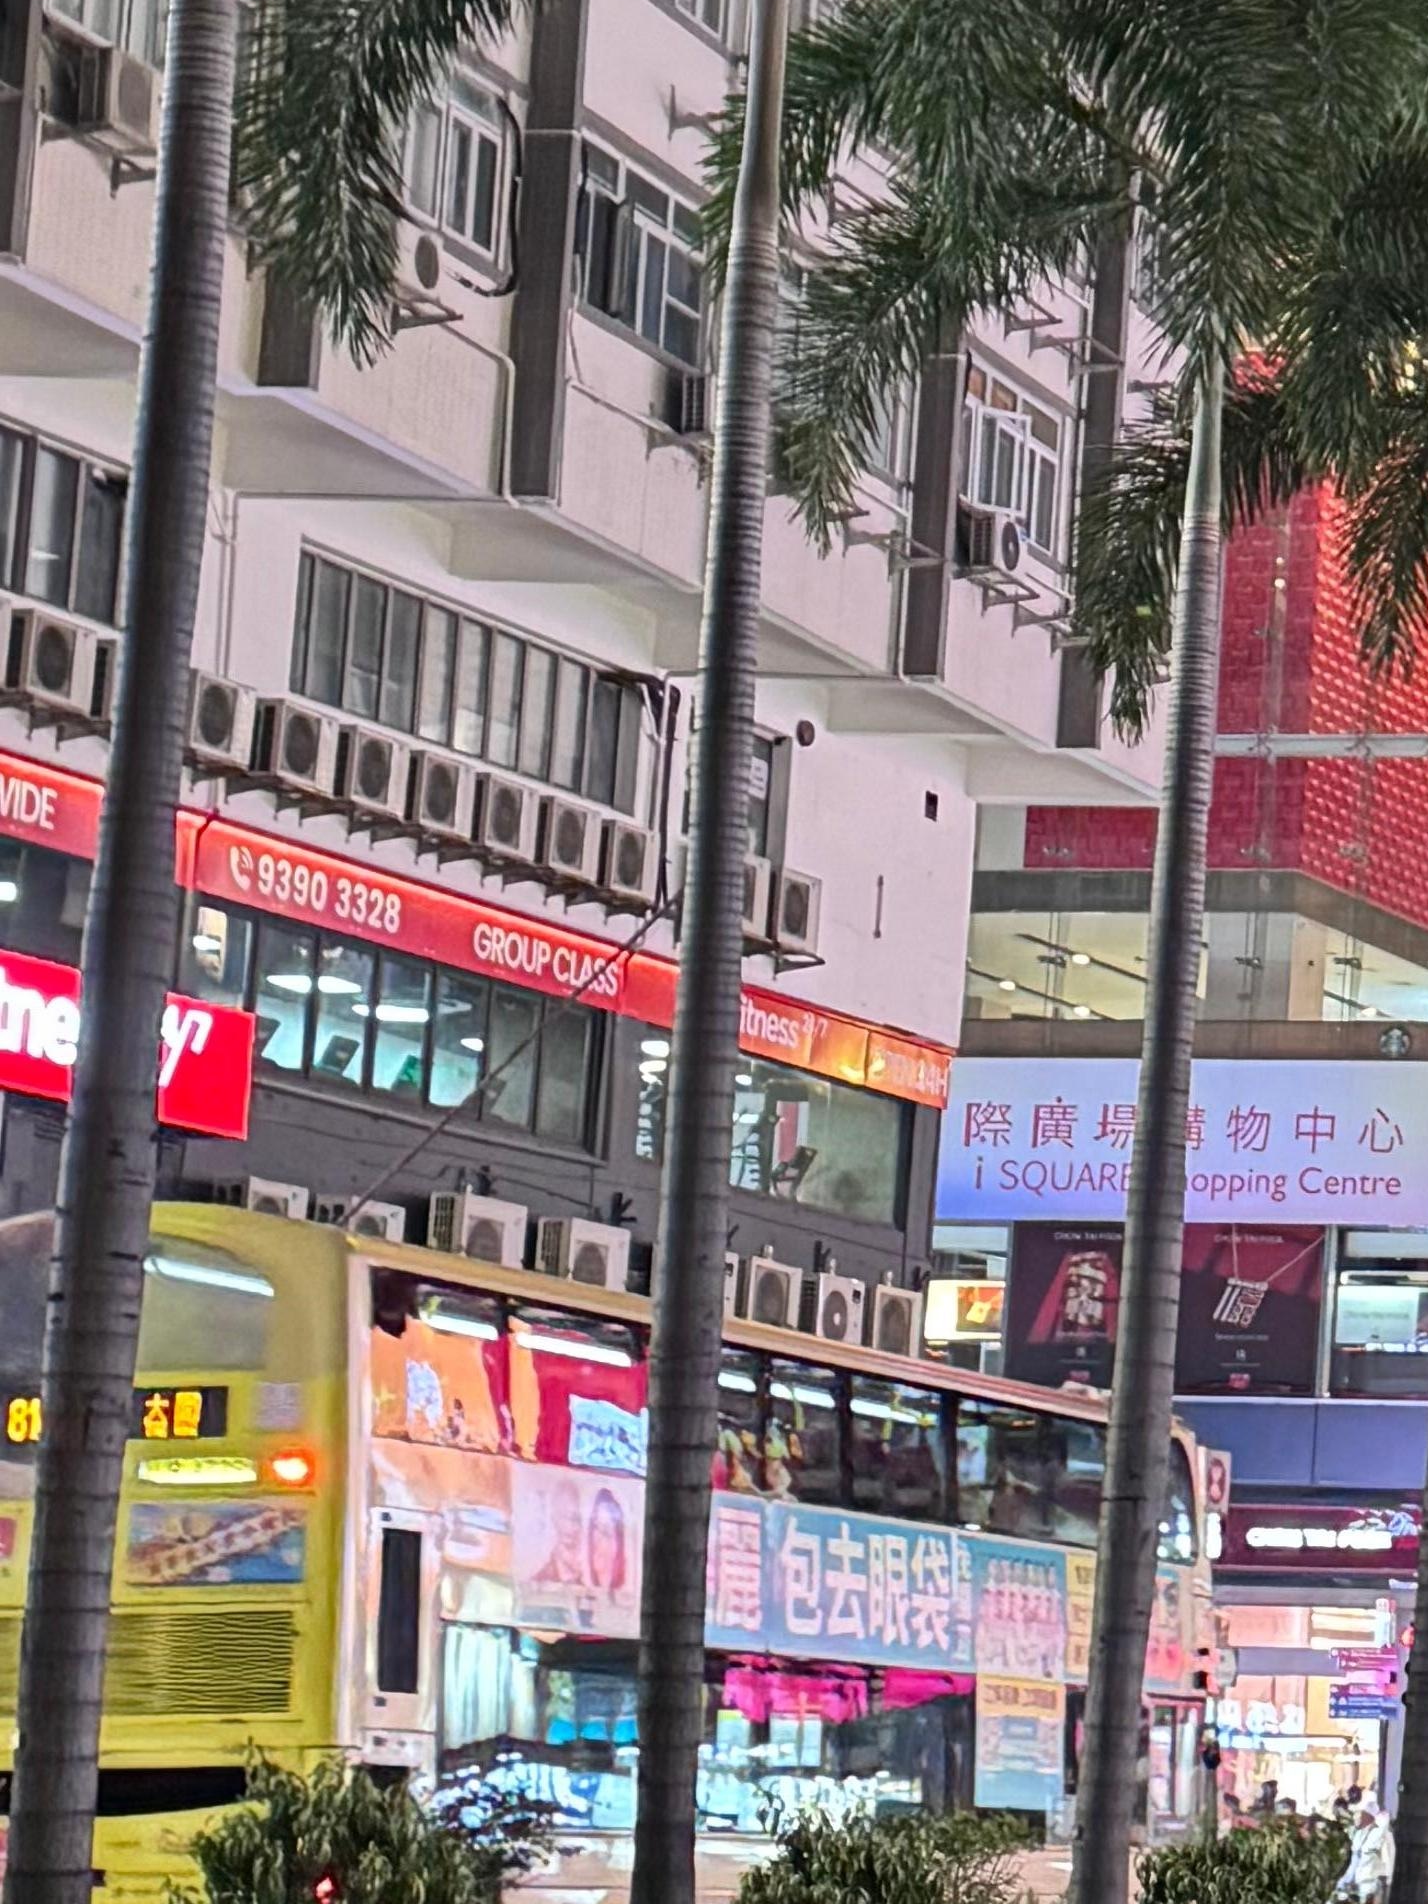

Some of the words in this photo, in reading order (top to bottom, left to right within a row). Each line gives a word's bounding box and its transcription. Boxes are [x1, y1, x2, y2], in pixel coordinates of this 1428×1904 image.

[258, 854, 328, 911] 9390
[335, 878, 401, 934] 3328
[473, 922, 550, 976] GROUP
[553, 946, 618, 996] CLASS
[1184, 1168, 1288, 1202] opping
[1298, 1166, 1402, 1195] Centre
